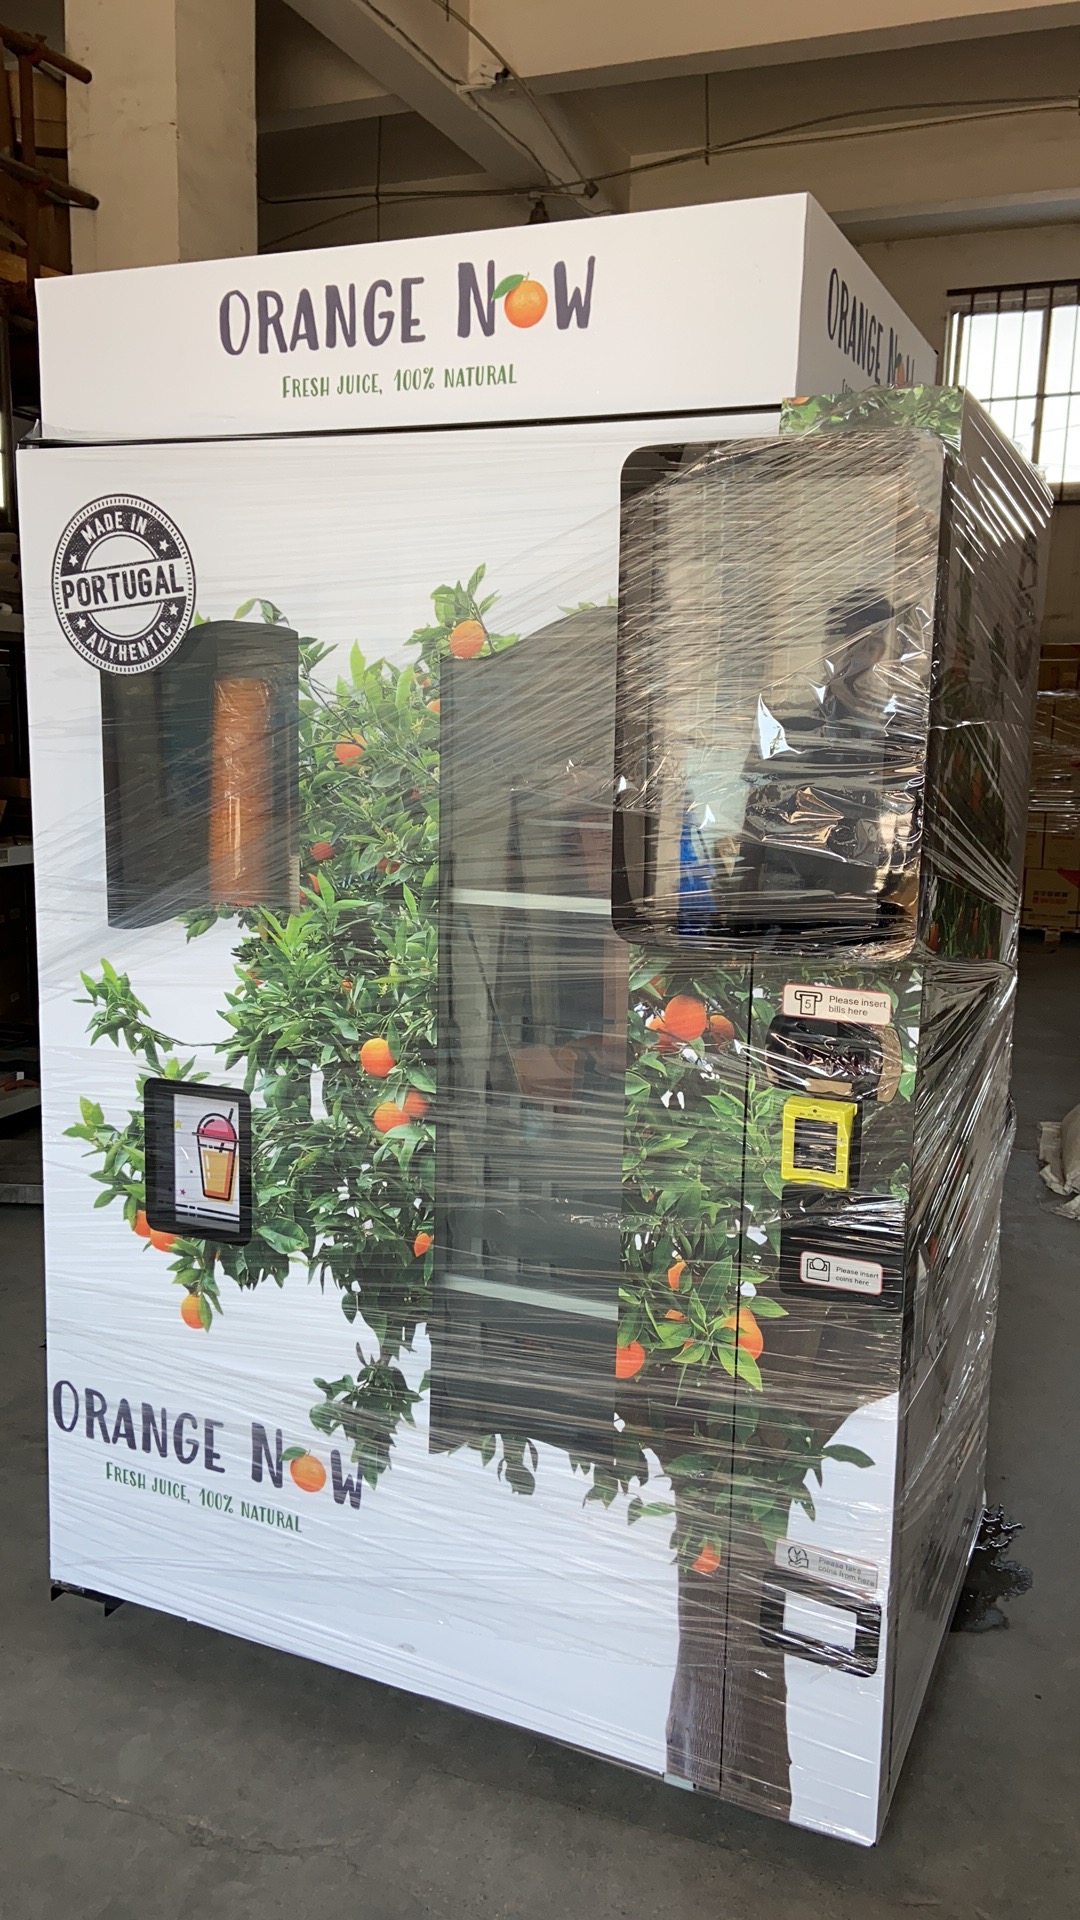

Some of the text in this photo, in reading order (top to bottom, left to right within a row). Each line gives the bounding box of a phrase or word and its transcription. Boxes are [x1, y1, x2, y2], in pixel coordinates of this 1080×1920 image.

[219, 277, 426, 356] ORANGE
[827, 268, 884, 385] ORANGE
[282, 363, 518, 398] FRESH JUICE, 100% NATURAL
[80, 511, 148, 545] MADE IN
[61, 563, 185, 609] PORTUGAL
[86, 621, 172, 662] AUTHENTIC
[804, 999, 812, 1009] 5
[828, 1005, 868, 1016] bills here
[829, 995, 887, 1009] Please insert
[835, 1276, 869, 1286] coins here
[836, 1266, 879, 1279] Please insert
[52, 1380, 225, 1474] ORANGE
[105, 1462, 302, 1533] FRESH JUICE, 100% NATURAL
[818, 1557, 862, 1575] Please take
[818, 1565, 875, 1587] coins from here
